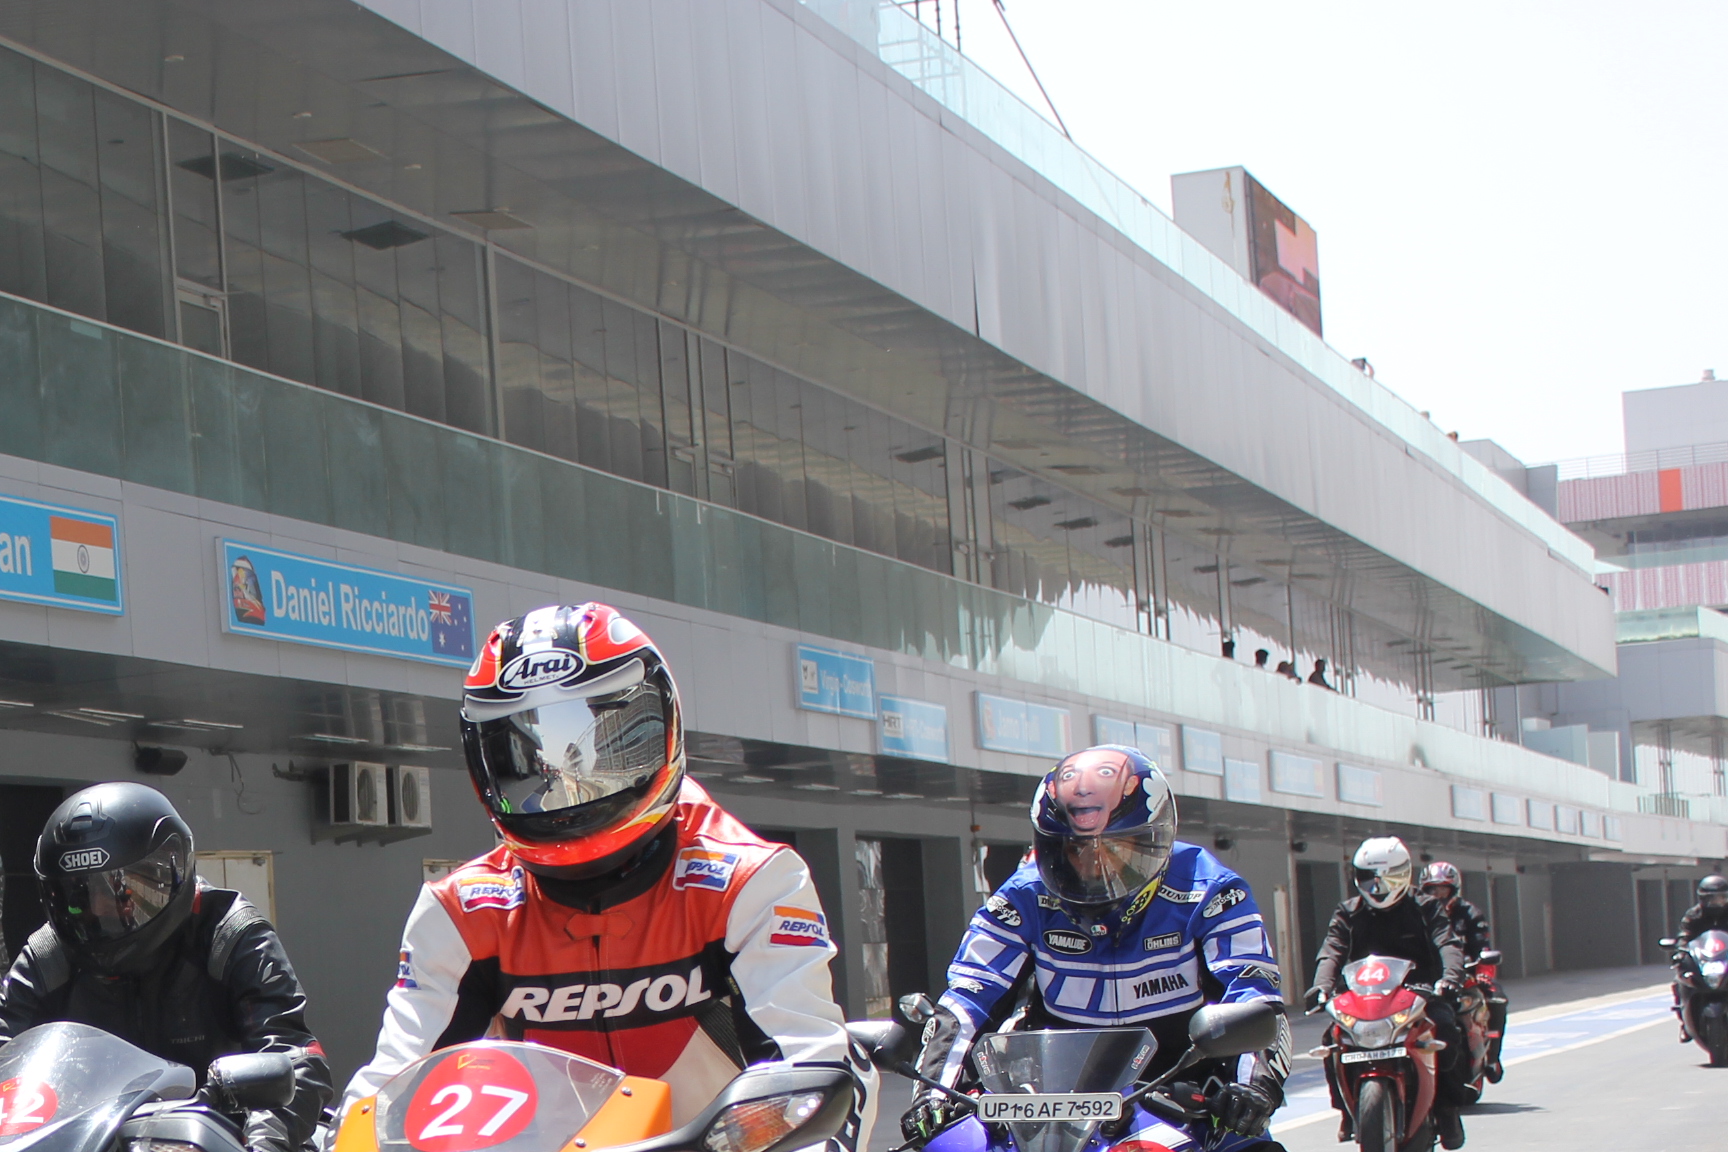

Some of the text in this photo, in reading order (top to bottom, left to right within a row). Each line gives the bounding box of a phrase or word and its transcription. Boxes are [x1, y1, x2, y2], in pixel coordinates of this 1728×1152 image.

[271, 570, 429, 642] Daniel Ricciardo
[503, 653, 573, 688] Arai
[883, 714, 902, 730] HRT
[64, 850, 103, 869] SHOEI
[1160, 887, 1203, 901] DUNLOP
[779, 919, 825, 937] REPSOL
[1048, 933, 1087, 951] YAMALUBE
[1357, 968, 1384, 982] 44
[499, 964, 712, 1023] REPSOL
[1133, 973, 1190, 999] YAMAHA
[419, 1084, 529, 1140] 27
[1038, 1101, 1063, 1118] AF
